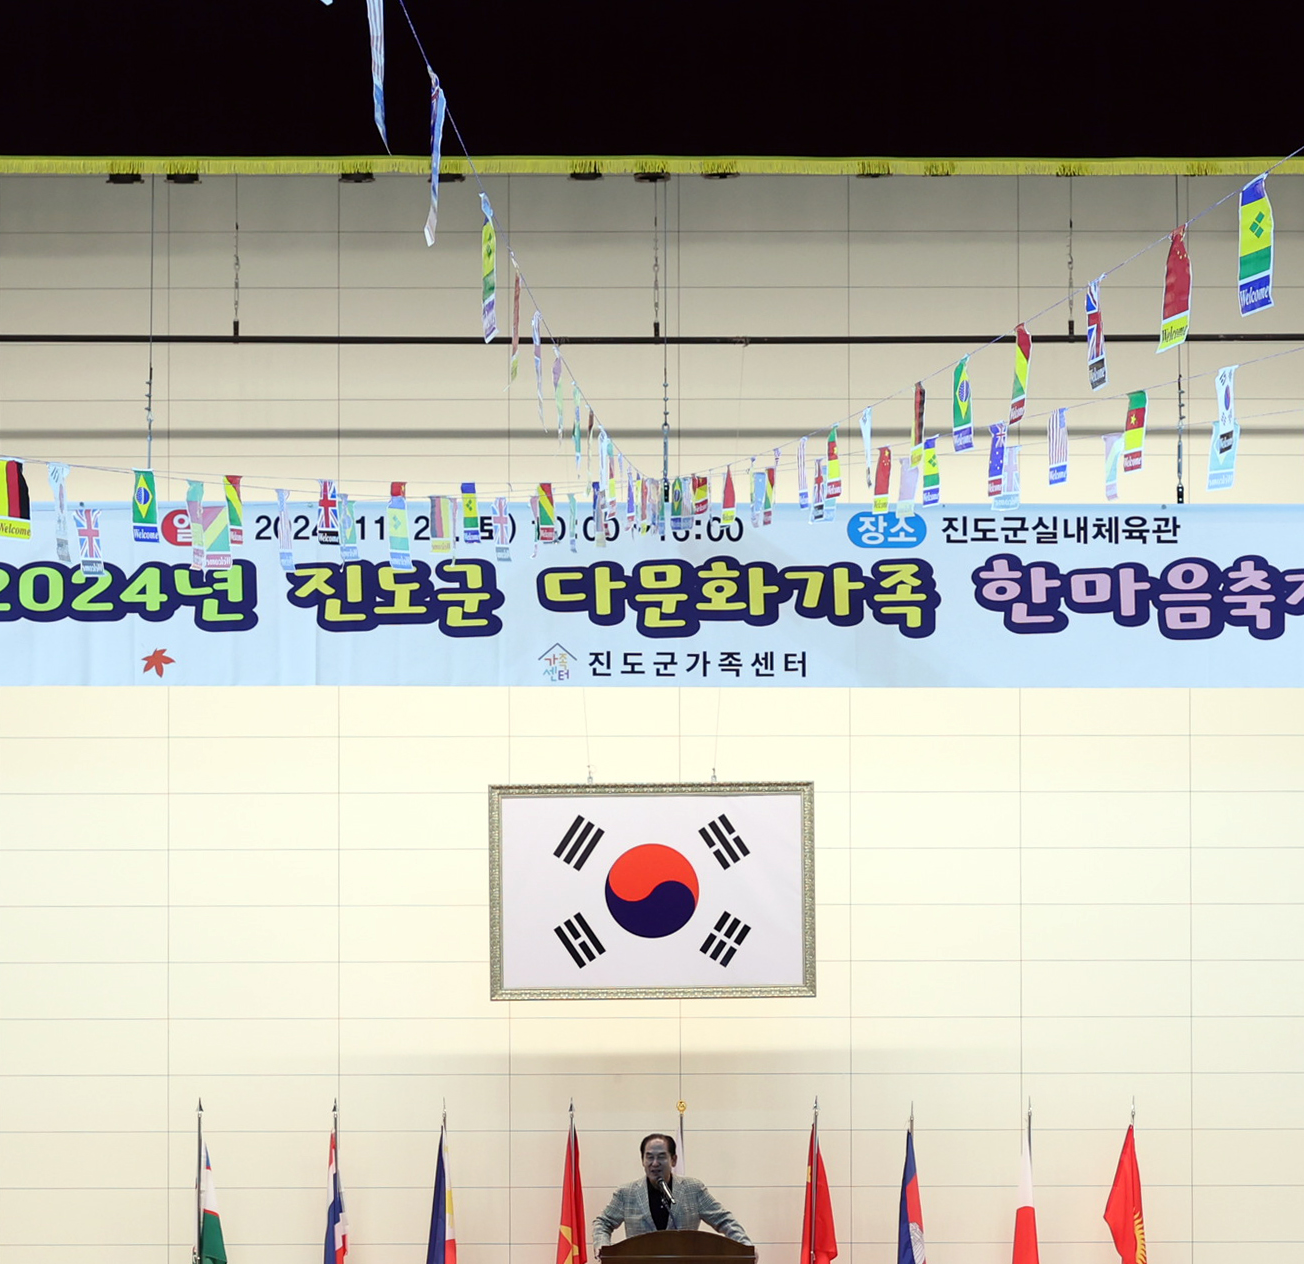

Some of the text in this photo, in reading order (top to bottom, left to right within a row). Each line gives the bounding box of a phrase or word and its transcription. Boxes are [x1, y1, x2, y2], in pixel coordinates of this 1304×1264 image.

[1238, 287, 1268, 308] Welcome
[857, 515, 917, 546] 장소
[941, 514, 1181, 544] 진도군실내체육관
[293, 561, 492, 628] 진도군
[543, 560, 933, 629] 다문화가족
[588, 651, 807, 677] 진도군가족센터
